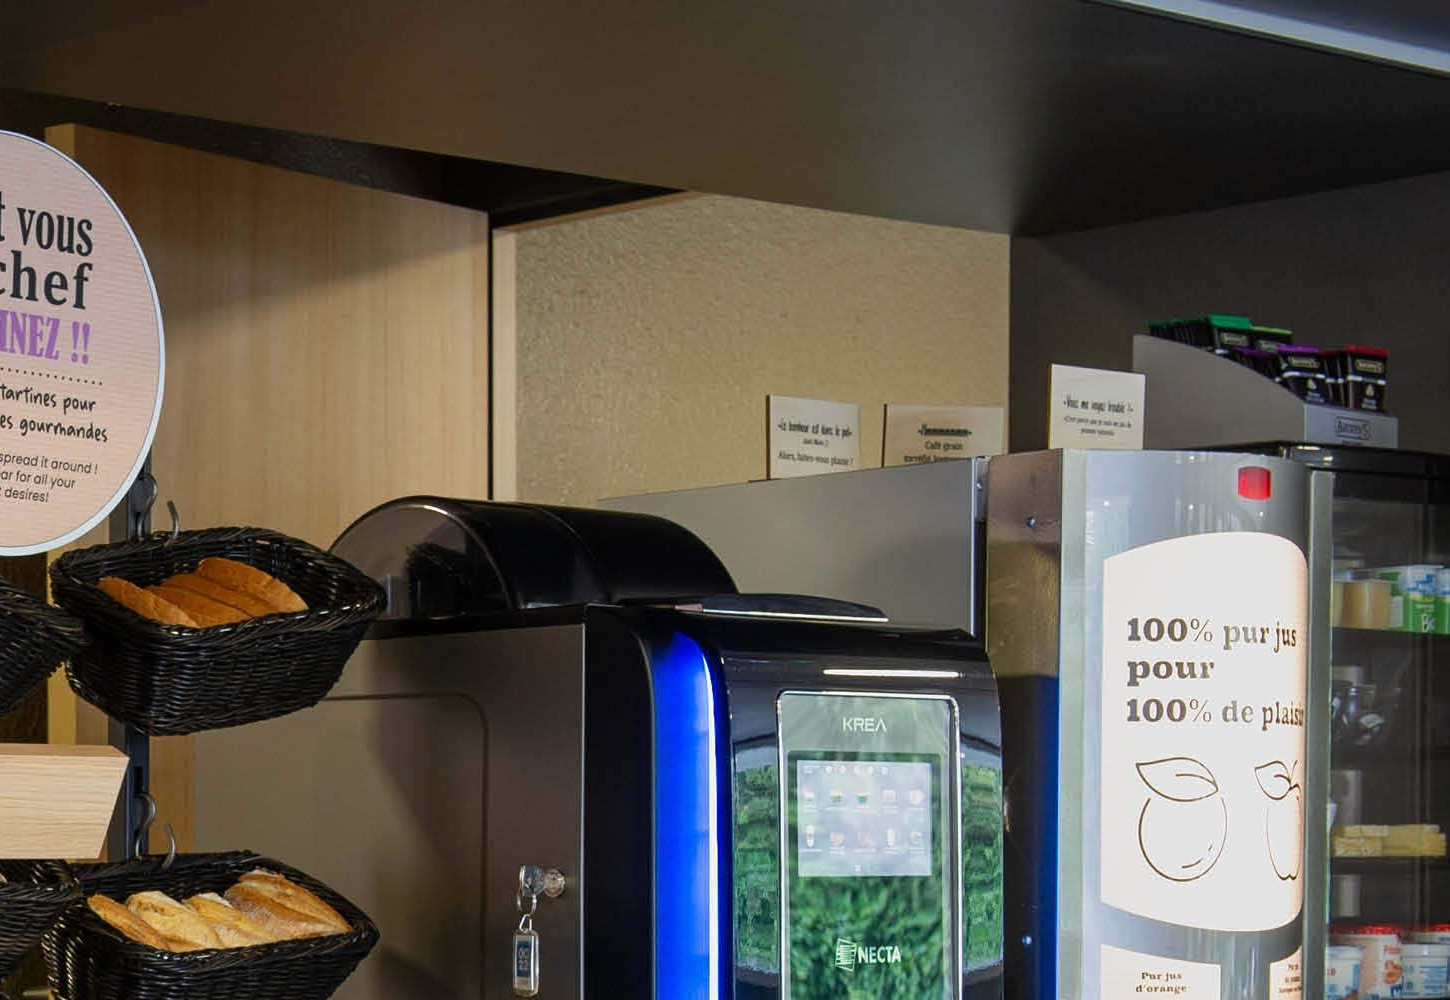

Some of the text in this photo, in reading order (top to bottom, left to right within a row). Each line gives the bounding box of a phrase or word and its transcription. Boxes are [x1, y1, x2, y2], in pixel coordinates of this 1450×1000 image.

[16, 206, 93, 257] vous
[71, 321, 91, 365] !!
[0, 383, 57, 408] tartines
[63, 397, 97, 415] pour
[19, 418, 108, 443] gourmandes
[41, 455, 49, 469] it
[51, 459, 92, 474] around
[15, 470, 31, 483] for
[34, 471, 48, 485] all
[50, 477, 76, 489] your
[5, 487, 49, 503] desires!
[1127, 617, 1297, 653] 100% pur jus
[1127, 660, 1215, 687] pour
[1126, 698, 1212, 723] 100%
[1222, 701, 1254, 723] de
[842, 717, 887, 732] KREA
[857, 946, 902, 964] NECTA
[1141, 971, 1182, 982] Pur jus
[1135, 984, 1188, 995] d'orange
